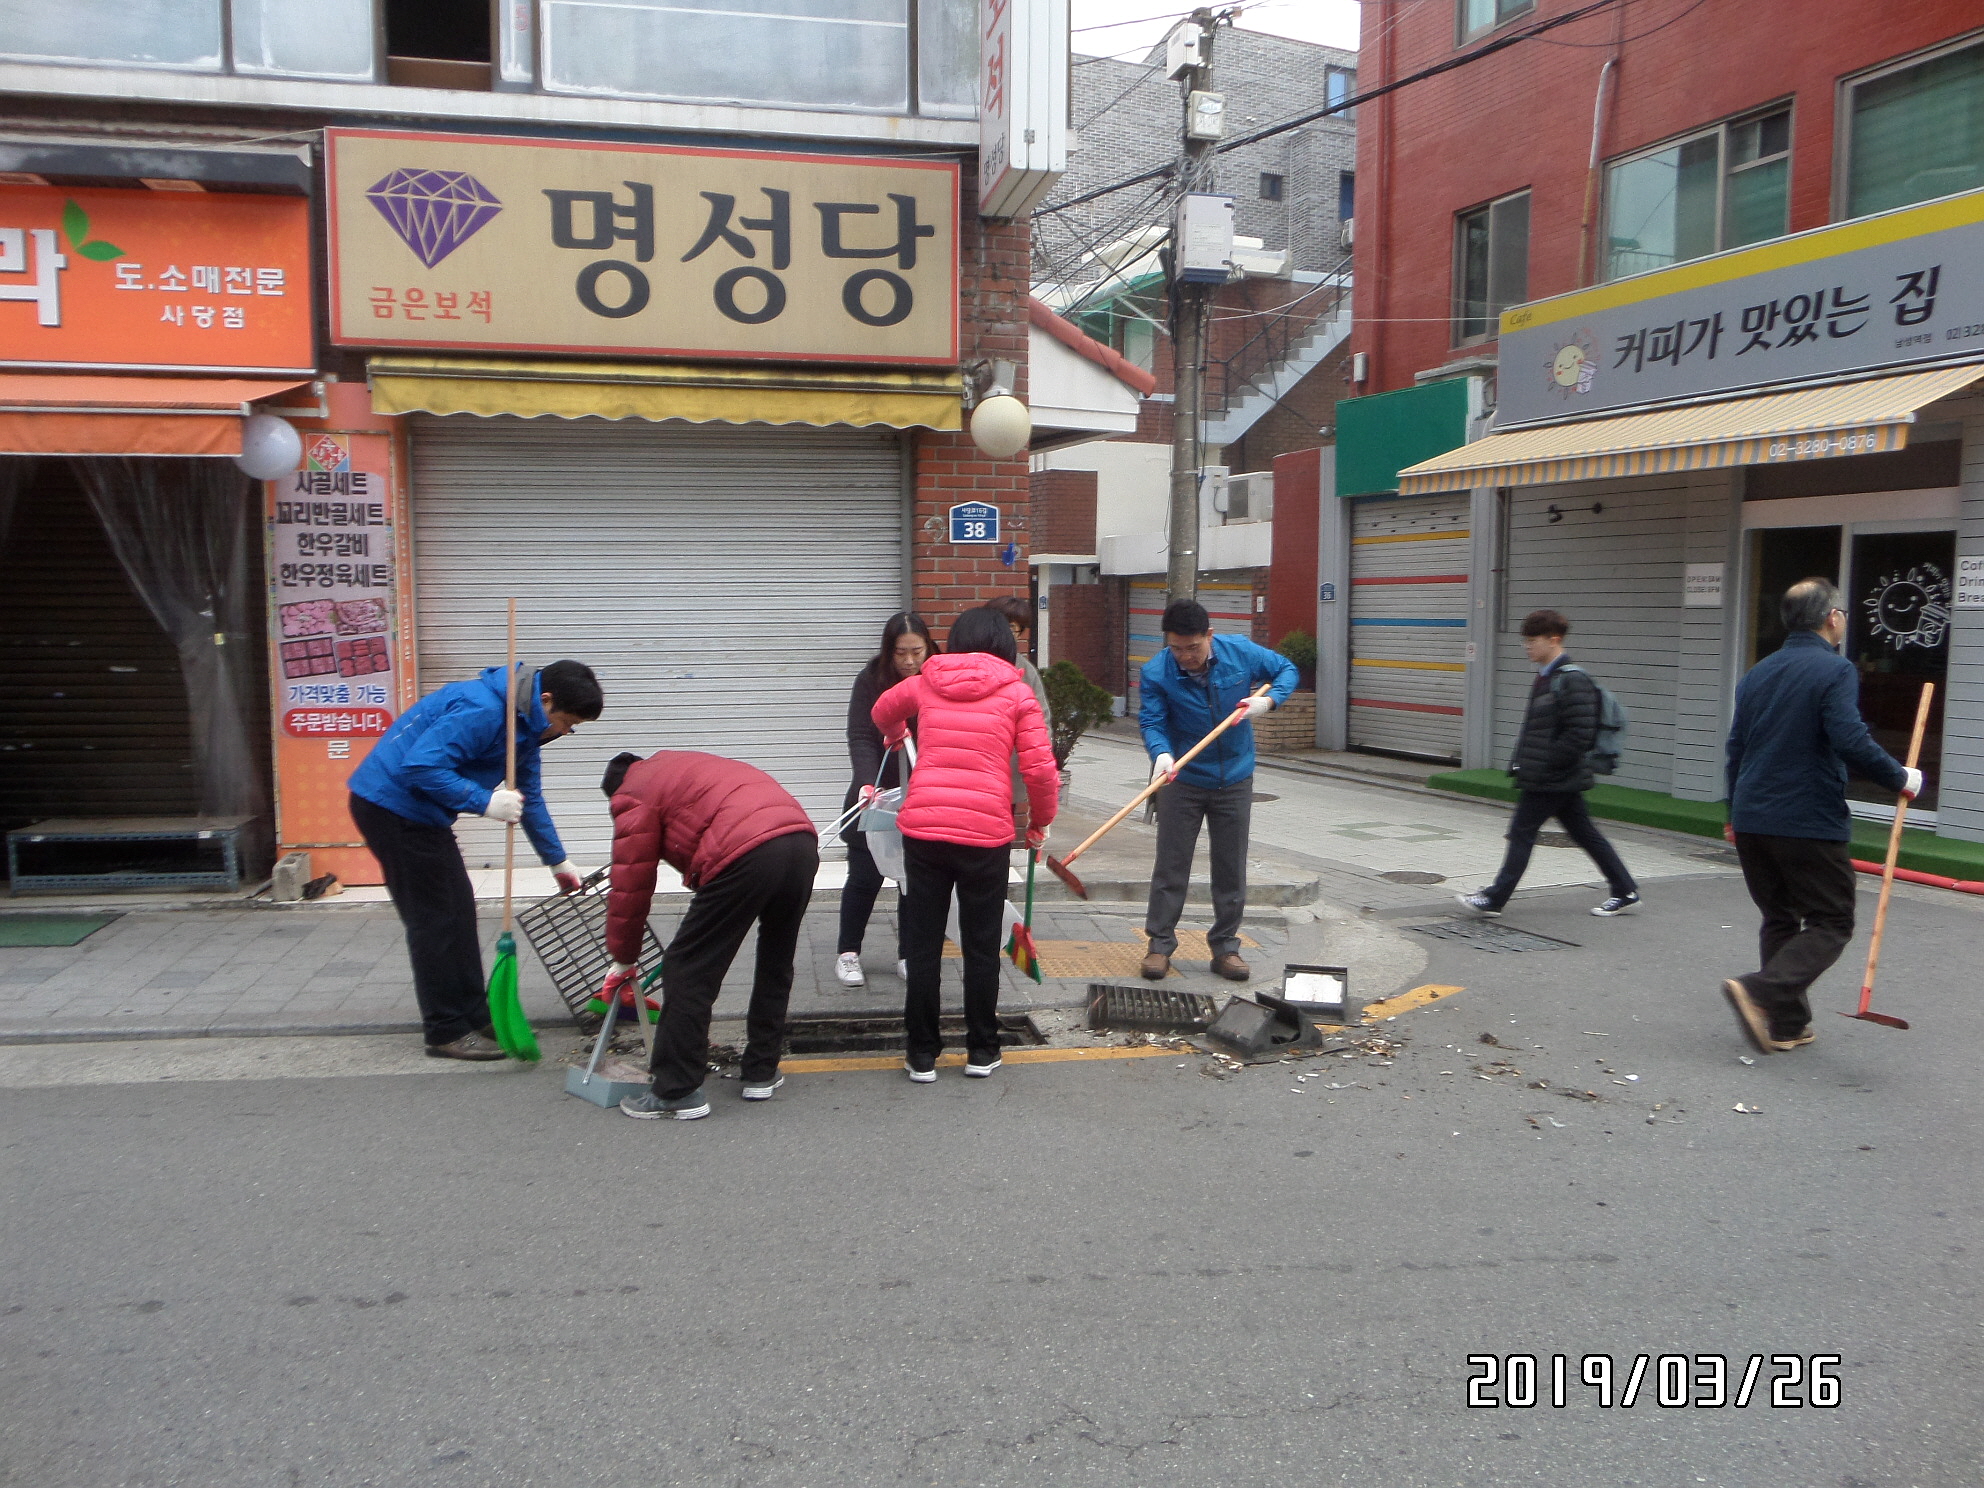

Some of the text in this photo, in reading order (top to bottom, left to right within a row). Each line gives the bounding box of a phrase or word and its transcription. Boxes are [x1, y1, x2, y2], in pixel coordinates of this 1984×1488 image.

[541, 180, 935, 327] 명성당
[115, 263, 285, 296] 도.소매전문
[160, 304, 245, 329] 사당점
[368, 286, 493, 324] 금은보석
[1613, 264, 1941, 373] 커피가 맛있는 집
[1769, 433, 1876, 457] 02-3280-0876
[295, 471, 368, 496] 사골세트
[276, 502, 385, 526] 꼬리반골세트
[963, 522, 986, 538] 38
[297, 532, 369, 557] 한우갈비
[280, 562, 389, 589] 한우정육세트
[288, 683, 387, 704] 가격맞춤 가능
[290, 710, 388, 733] 주문받습니다.
[327, 739, 351, 760] 문
